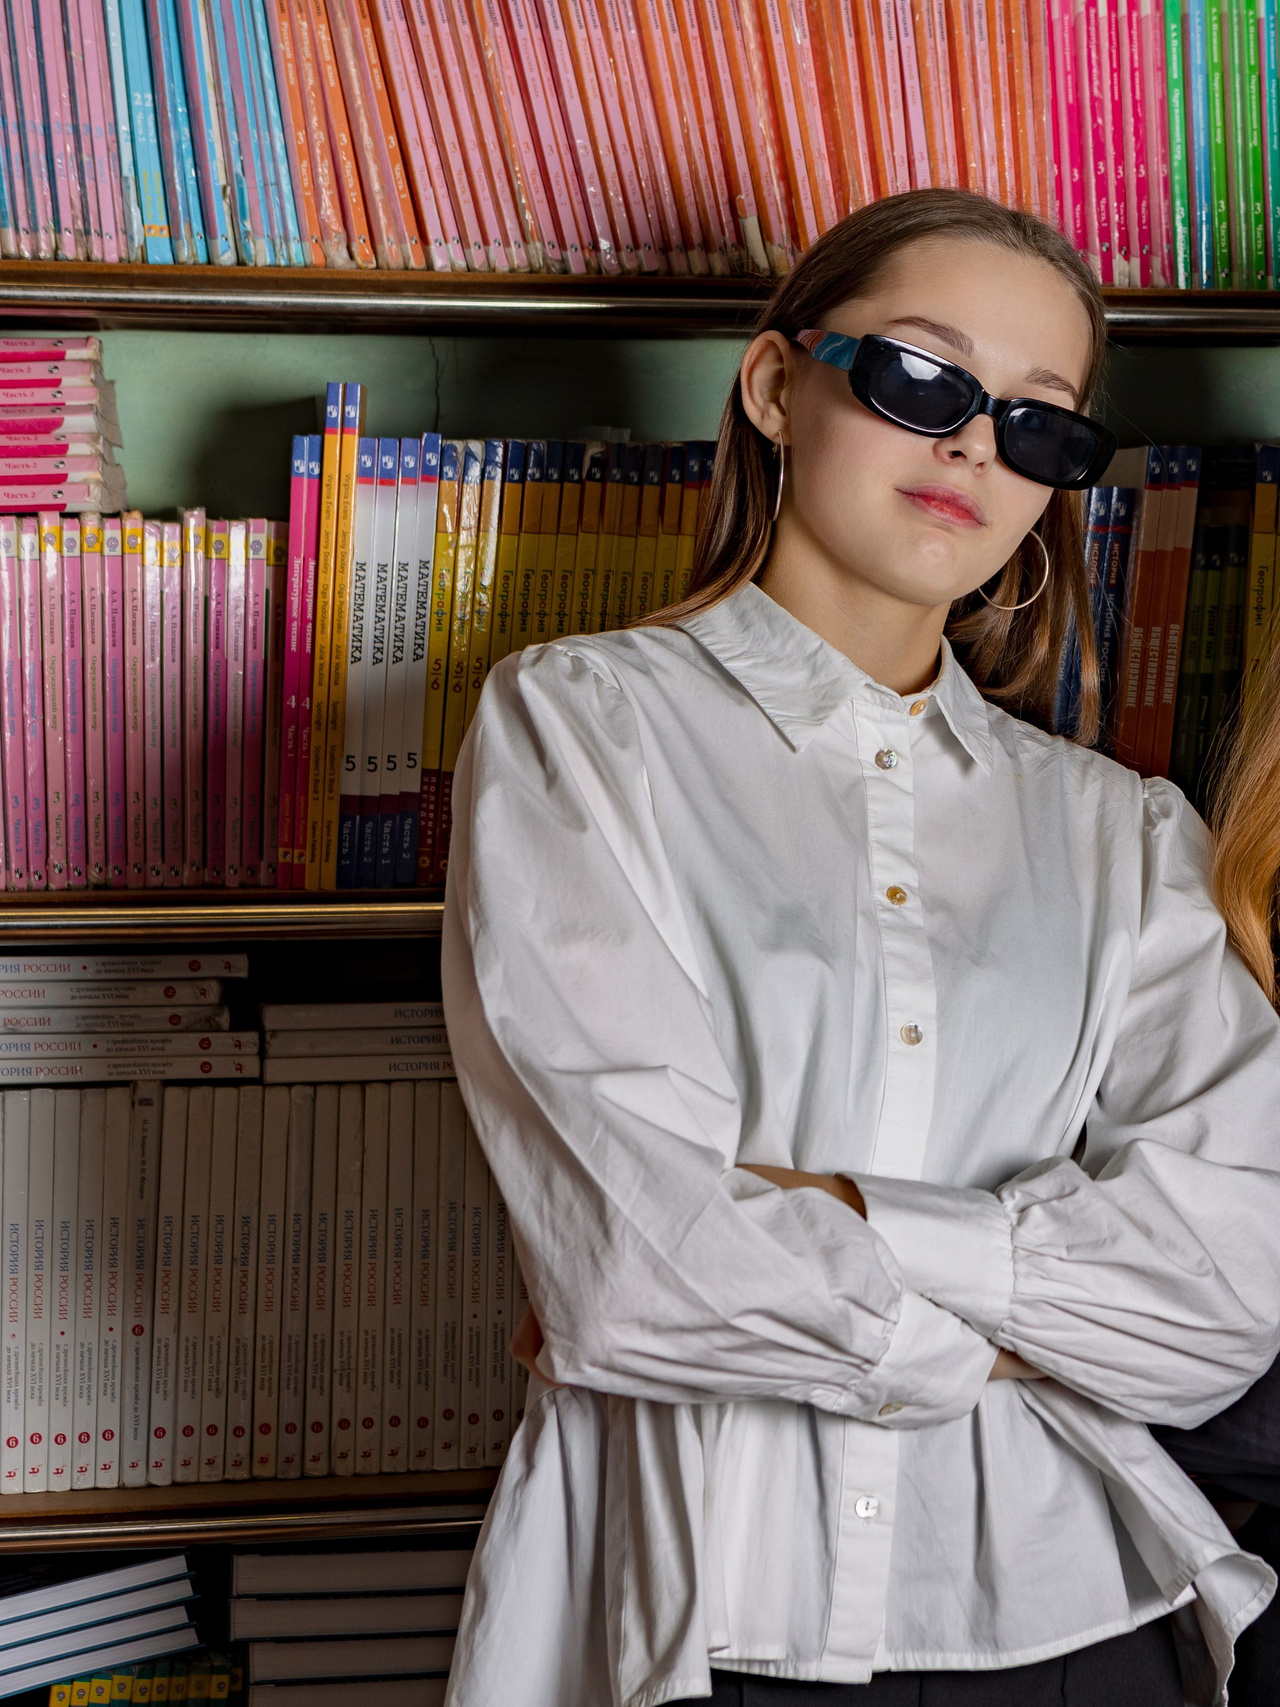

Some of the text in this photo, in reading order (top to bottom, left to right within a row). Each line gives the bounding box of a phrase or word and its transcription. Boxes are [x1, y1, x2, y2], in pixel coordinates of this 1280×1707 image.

[364, 27, 382, 91] Русский язык
[388, 135, 397, 149] 3
[393, 162, 404, 191] Часть
[1072, 167, 1079, 182] 3
[1218, 200, 1226, 213] 3
[3, 492, 29, 500] Часть
[325, 474, 334, 500] Virginia
[324, 501, 333, 521] Evans
[1108, 543, 1120, 585] ИСТОРИЯ
[350, 561, 367, 665] МАТЕМАТИКА
[372, 562, 388, 666] МАТЕМАТИКА
[392, 561, 409, 665] МАТЕМАТИКА
[412, 559, 430, 662] МАТЕМАТИКА
[434, 568, 450, 632] География
[498, 570, 513, 633] География
[519, 568, 535, 632] География
[537, 569, 553, 633] География
[556, 569, 572, 633] География
[578, 568, 595, 632] География
[305, 621, 313, 654] чтение
[432, 658, 442, 671] 5
[474, 657, 483, 671] 5
[1126, 626, 1143, 708] ОБЩЕСТВОЗНАНИЕ
[1144, 626, 1162, 707] ОБЩЕСТВОЗНАНИЕ
[1162, 623, 1180, 705] ОБЩЕСТВОЗНАНИЕ
[431, 677, 440, 691] 6
[472, 676, 481, 690] 6
[287, 694, 297, 709] 4
[301, 696, 311, 710] 4
[302, 727, 310, 754] Часть
[345, 755, 356, 772] 5
[367, 756, 378, 773] 5
[386, 754, 398, 771] 5
[406, 752, 418, 769] 5
[92, 791, 99, 804] 3
[421, 776, 430, 827] ЗВЕЗДА
[427, 776, 436, 846] ПОЛЯРНАЯ
[94, 813, 102, 842] Часть
[341, 820, 351, 854] Часть
[364, 821, 373, 853] Часть
[382, 820, 392, 854] Часть
[403, 817, 413, 849] Часть
[23, 963, 71, 974] РОССИИ
[3, 1017, 50, 1028] РОССИИ
[34, 1041, 82, 1052] РОССИИ
[391, 1034, 442, 1046] ИСТОРИЯ
[35, 1066, 83, 1077] РОССИИ
[389, 1061, 440, 1072] ИСТОРИЯ
[9, 1223, 19, 1323] ИСТОРИЯ РОССИИ
[34, 1220, 44, 1319] ИСТОРИЯ РОССИИ
[59, 1221, 70, 1321] ИСТОРИЯ РОССИИ
[83, 1220, 94, 1319] ИСТОРИЯ РОССИИ
[107, 1217, 119, 1317] ИСТОРИЯ РОССИИ
[188, 1214, 200, 1314] ИСТОРИЯ РОССИИ
[264, 1214, 277, 1312] ИСТОРИЯ РОССИИ
[420, 1209, 431, 1307] ИСТОРИЯ РОССИИ
